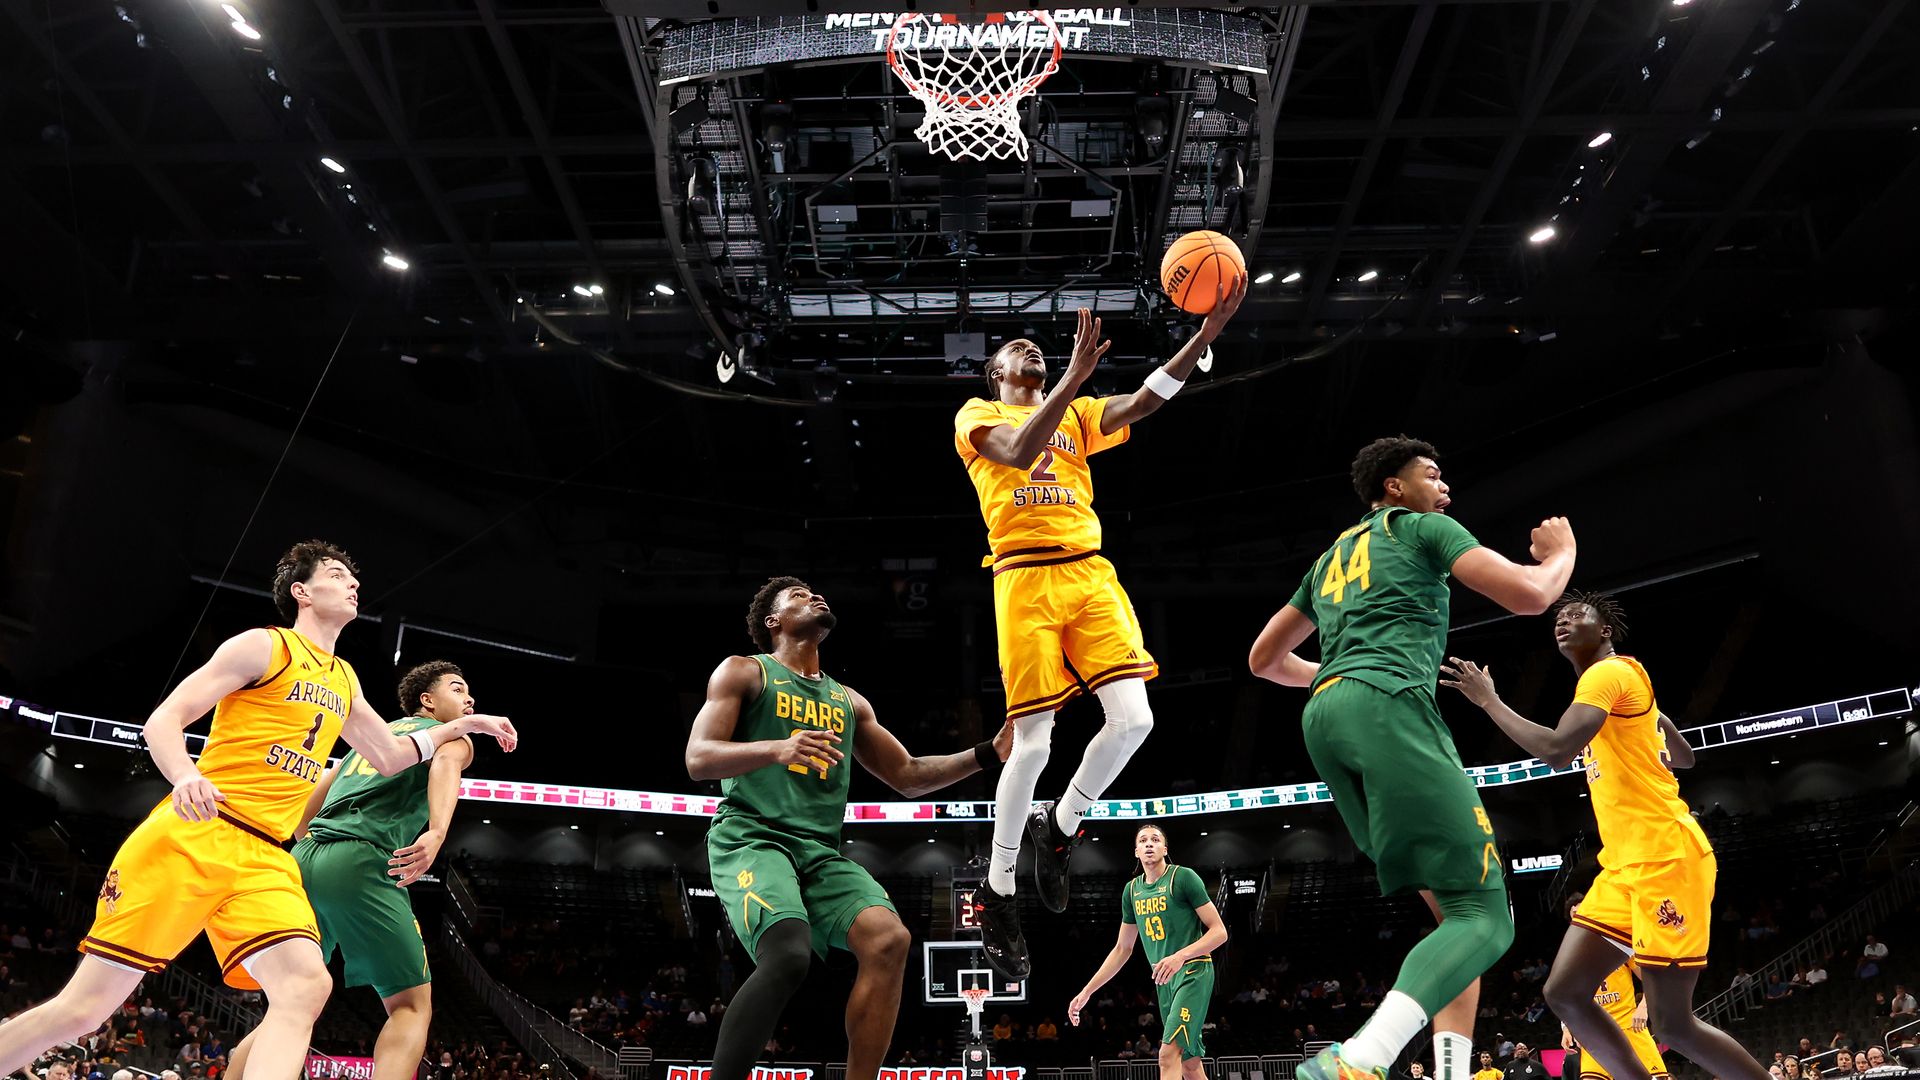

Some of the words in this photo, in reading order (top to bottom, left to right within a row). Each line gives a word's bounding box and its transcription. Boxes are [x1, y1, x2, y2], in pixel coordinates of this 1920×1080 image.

[871, 24, 1090, 51] TOURNAMENT
[1030, 447, 1058, 482] 2
[1013, 486, 1076, 507] STATE
[1321, 530, 1371, 604] 44
[776, 691, 845, 734] BEARS
[1735, 715, 1804, 736] Northwestern
[112, 727, 138, 741] Penn
[302, 712, 324, 752] 1
[265, 744, 322, 784] STATE
[1512, 854, 1563, 871] UMB
[1135, 895, 1167, 915] BEARS
[1145, 916, 1166, 941] 43
